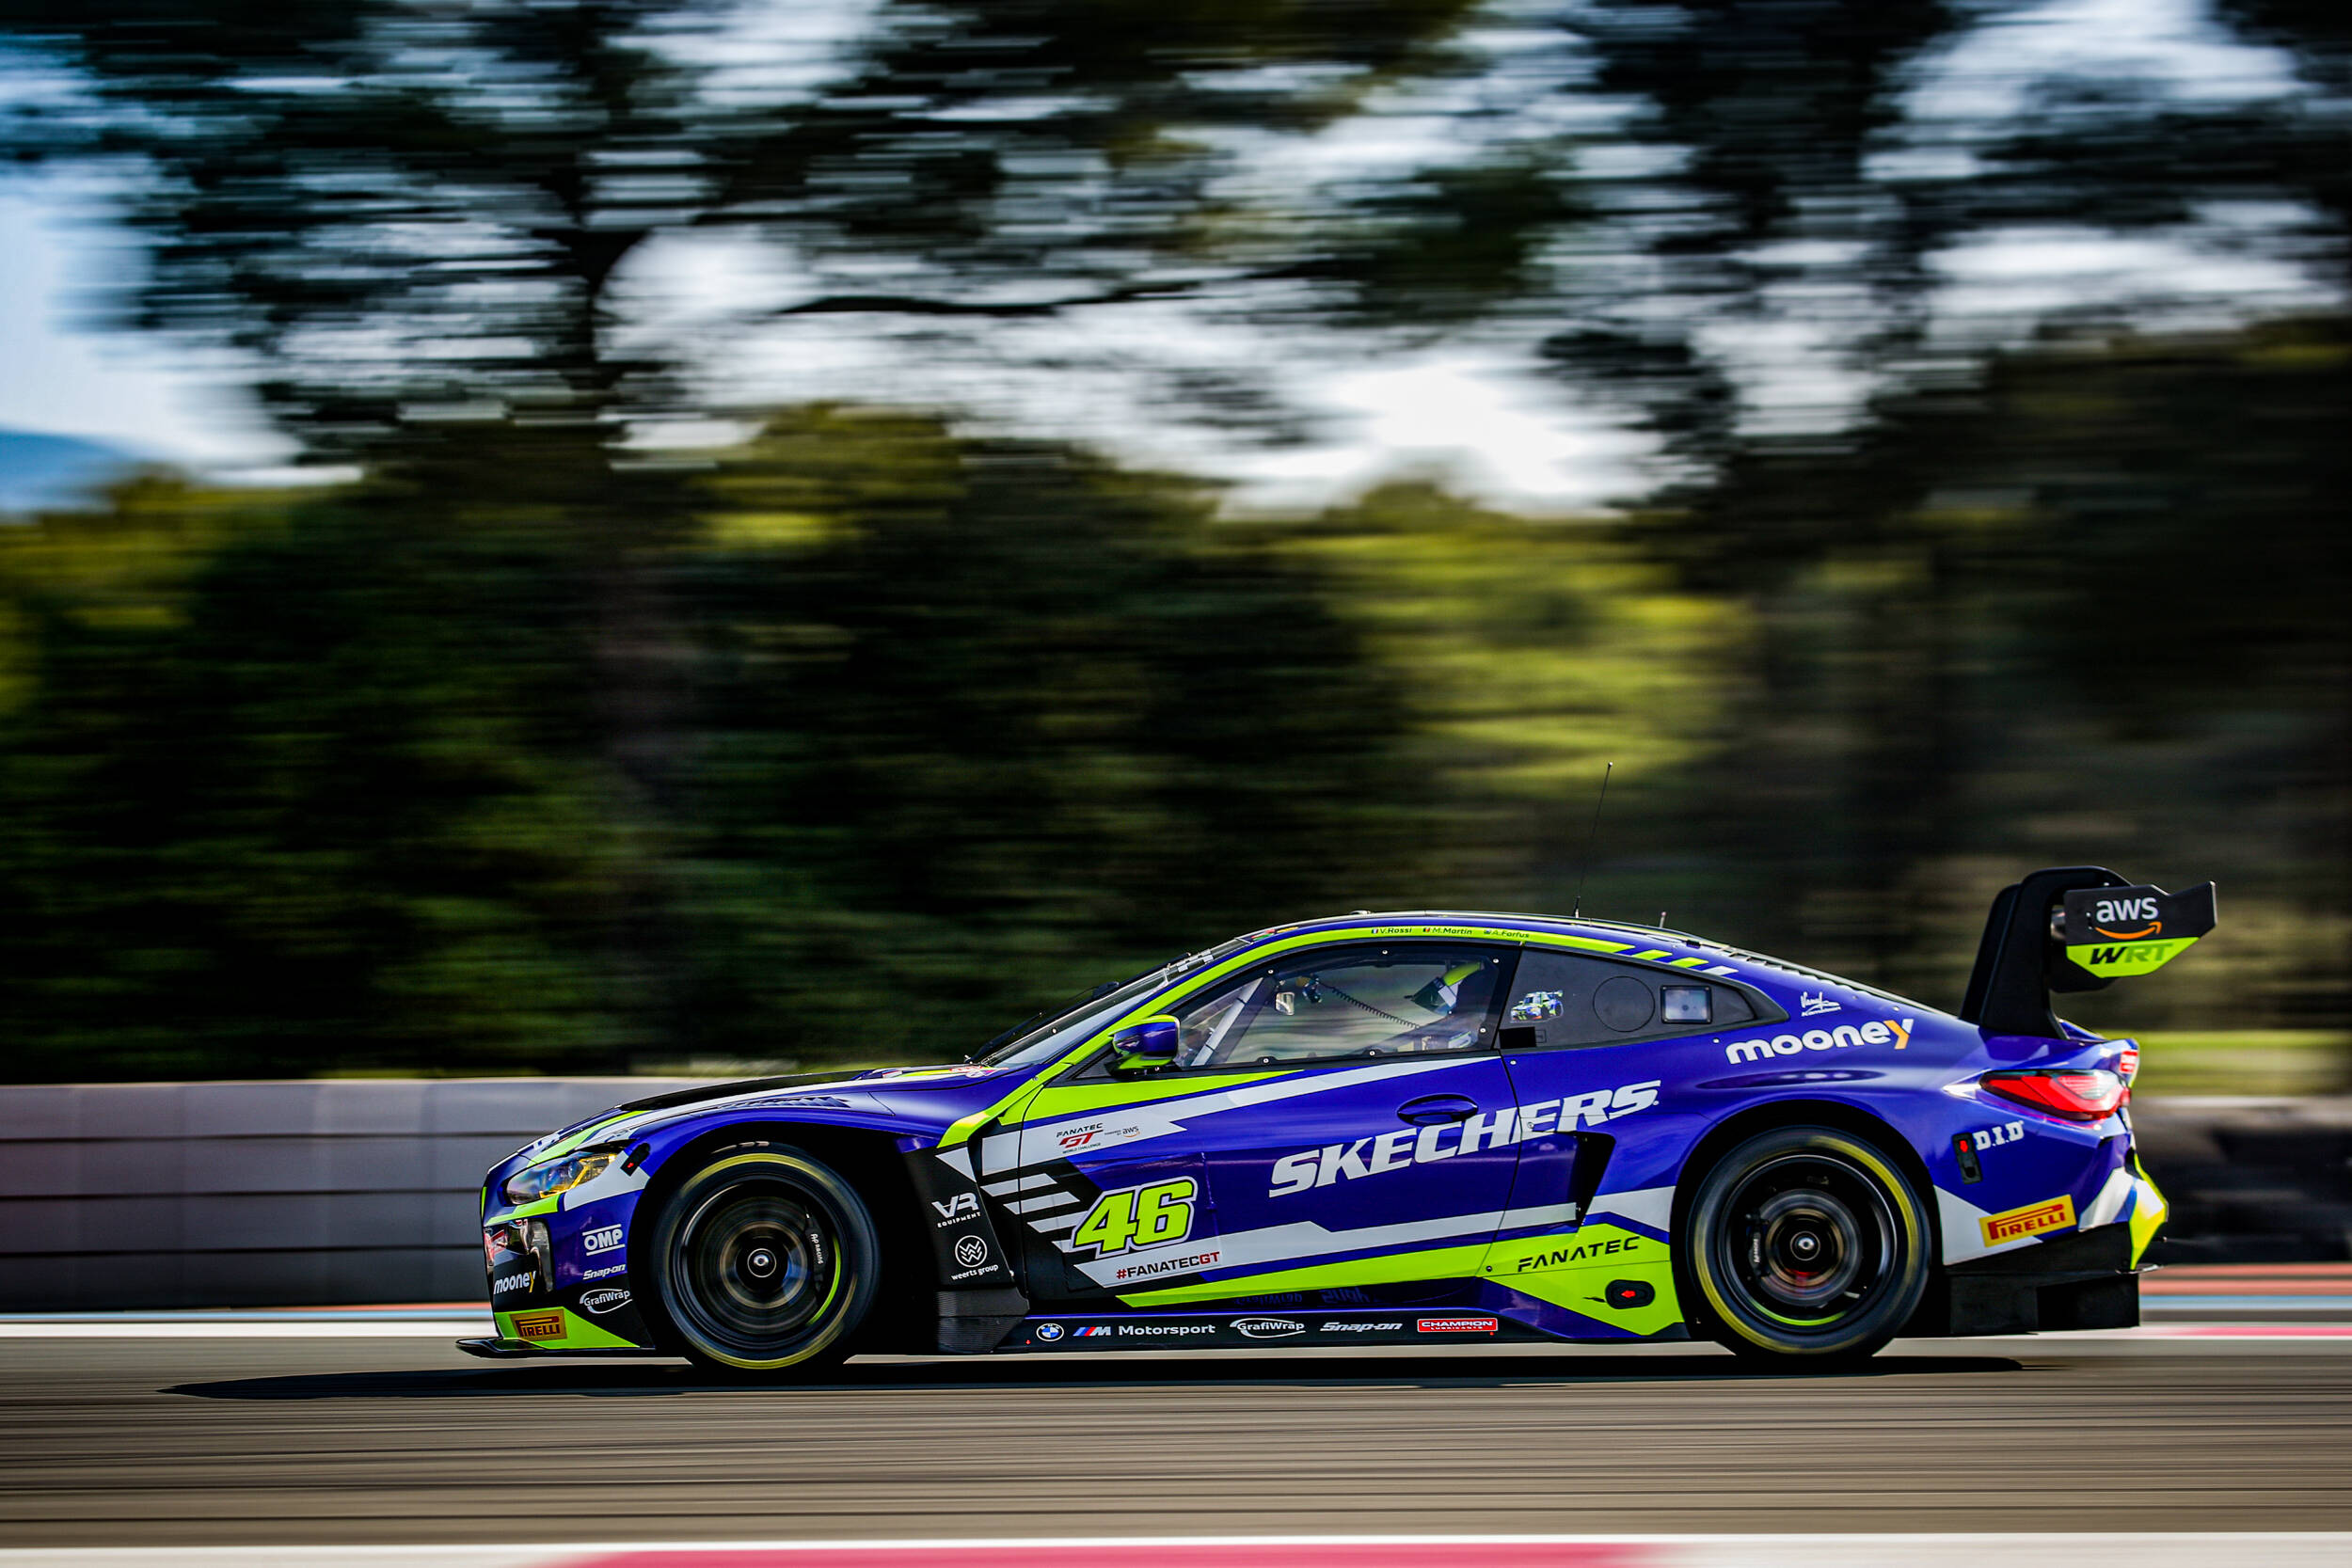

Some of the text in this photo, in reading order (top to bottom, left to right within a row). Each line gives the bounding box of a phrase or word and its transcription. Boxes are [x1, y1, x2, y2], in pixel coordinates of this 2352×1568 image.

[2096, 897, 2159, 923] aws
[2090, 943, 2173, 965] WRT
[1725, 1019, 1914, 1065] mooney
[1056, 1122, 1104, 1138] FANATEC
[1058, 1130, 1104, 1148] GT
[1269, 1080, 1661, 1197] SKECHERS
[1972, 1121, 2025, 1150] D.I.D
[931, 1192, 979, 1218] VR
[937, 1212, 981, 1227] EQUIPMENT
[1072, 1176, 1199, 1259] 46
[1987, 1204, 2066, 1240] PIRELLI
[583, 1228, 624, 1251] OMP
[1116, 1251, 1220, 1279] #FANATECGT
[1518, 1236, 1640, 1273] FANATEC
[493, 1270, 536, 1294] mooney
[582, 1263, 627, 1280] Snap-on
[951, 1264, 999, 1280] weerts group
[583, 1290, 630, 1307] GrafiWrap
[515, 1316, 561, 1337] PIRELLI
[1119, 1324, 1216, 1336] Motorsport
[1237, 1322, 1305, 1333] GrafiWrap
[1320, 1322, 1404, 1333] Snap-on
